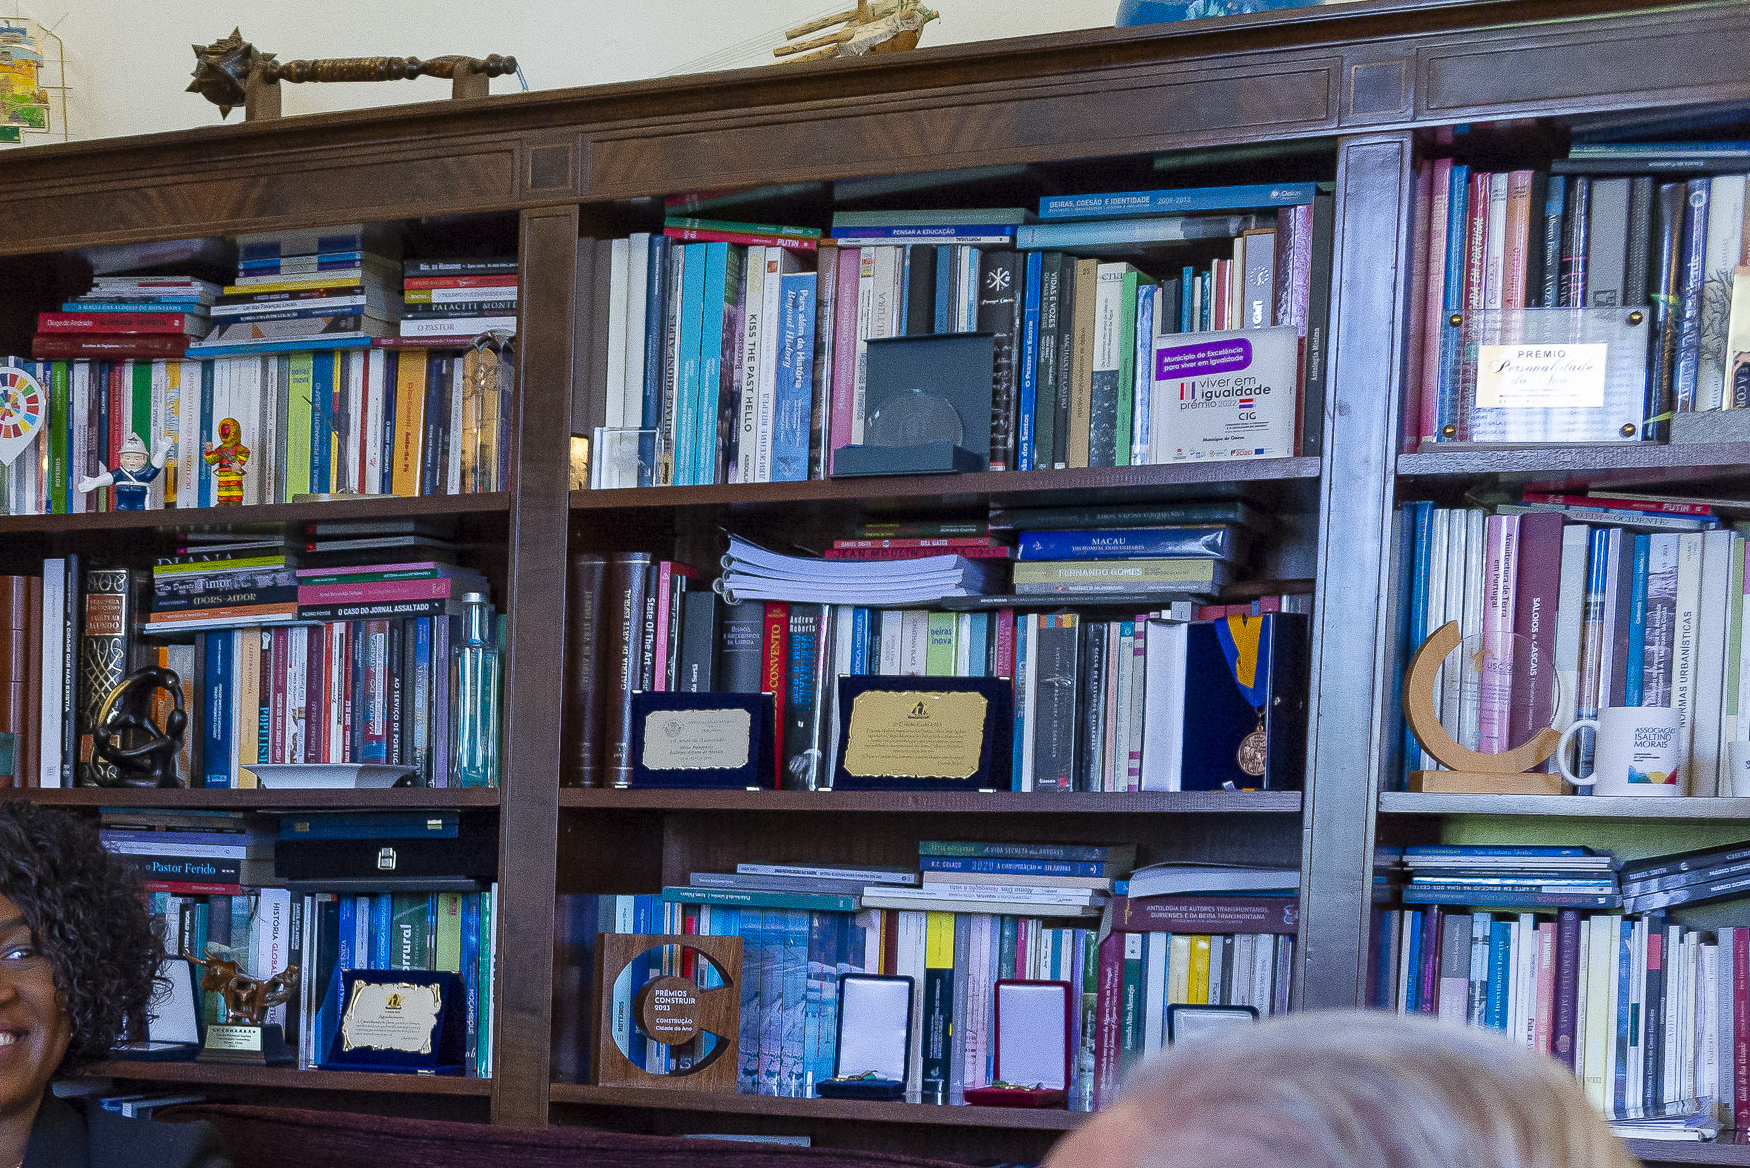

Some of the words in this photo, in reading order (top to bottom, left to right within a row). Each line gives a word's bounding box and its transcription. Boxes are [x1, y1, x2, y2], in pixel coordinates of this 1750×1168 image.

[1049, 200, 1073, 208] OEIRAS,
[1076, 197, 1102, 207] COESÃO
[1109, 196, 1150, 205] IDENTIDADE
[892, 228, 915, 236] PENSAR
[923, 227, 955, 235] EDUCAÇÃO
[1471, 216, 1483, 264] PORTUGAL
[776, 237, 799, 247] PUTIN
[1048, 271, 1058, 294] VIDAS
[1470, 268, 1480, 282] EM
[783, 289, 797, 328] Beyond
[797, 289, 809, 311] Para
[797, 313, 808, 336] além
[1048, 302, 1056, 328] VOZES
[748, 313, 758, 338] KISS
[747, 341, 756, 362] THE
[782, 329, 795, 368] History
[796, 337, 806, 349] da
[1163, 353, 1196, 364] Município
[1196, 351, 1206, 360] de
[1206, 346, 1243, 358] Excelência
[1164, 364, 1180, 373] para
[1180, 361, 1197, 369] viver
[1210, 354, 1244, 367] igualdade
[745, 365, 755, 394] PAST
[794, 350, 806, 389] História
[1199, 377, 1231, 389] viver
[1234, 376, 1256, 387] em
[1200, 384, 1271, 401] igualdade
[744, 396, 754, 432] HELLO
[1180, 398, 1217, 411] prémio
[1217, 399, 1237, 408] 2022
[1238, 411, 1256, 421] CIG
[1662, 503, 1690, 512] PUTIN
[1091, 537, 1126, 546] MACAU
[1501, 532, 1513, 584] Arquitectura
[1058, 568, 1108, 577] FERNANDO
[1110, 568, 1143, 576] GOMES
[1490, 573, 1501, 609] Portugal
[1502, 584, 1511, 595] de
[343, 608, 360, 616] CASO
[370, 605, 393, 614] JORNAL
[394, 603, 429, 612] ASSALTADO
[623, 589, 632, 618] ESPIRAL
[646, 597, 655, 620] State
[1501, 596, 1510, 618] Terra
[789, 615, 814, 624] Andrew
[1531, 597, 1541, 633] SALOIOS
[622, 621, 630, 642] ARTE
[645, 621, 654, 633] Of
[789, 624, 816, 633] Roberts
[930, 627, 952, 636] oeiras
[645, 633, 653, 650] The
[931, 637, 952, 645] inova
[1679, 610, 1692, 683] URBANÍSTICAS
[644, 651, 652, 665] Art
[768, 624, 781, 688] CONVENTO
[1529, 641, 1538, 676] CASCAIS
[620, 657, 629, 691] GALERIA
[392, 690, 400, 720] SERVIÇO
[1634, 726, 1676, 735] ASSOCIAÇÃO
[1634, 733, 1671, 742] ISALTINO
[1633, 740, 1668, 749] MORAIS
[152, 861, 183, 873] Pastor
[184, 862, 217, 875] Ferido
[1216, 906, 1270, 914] TRANSMONTANOS,
[1217, 913, 1266, 921] TRANSMONTANA
[272, 902, 281, 940] HISTÓRIA
[1564, 925, 1572, 947] THE
[270, 943, 279, 976] GLOBAL
[654, 988, 687, 997] PRÉMIOS
[654, 997, 696, 1005] CONSTRUIR
[1126, 984, 1135, 1011] Alentejo
[467, 988, 475, 1035] MOÇAMBIQUE
[617, 1000, 625, 1033] ROTEIROS
[655, 1017, 693, 1025] CONSTRUÇÃO
[1560, 994, 1569, 1029] IMAMS
[1125, 1027, 1133, 1051] Agenda
